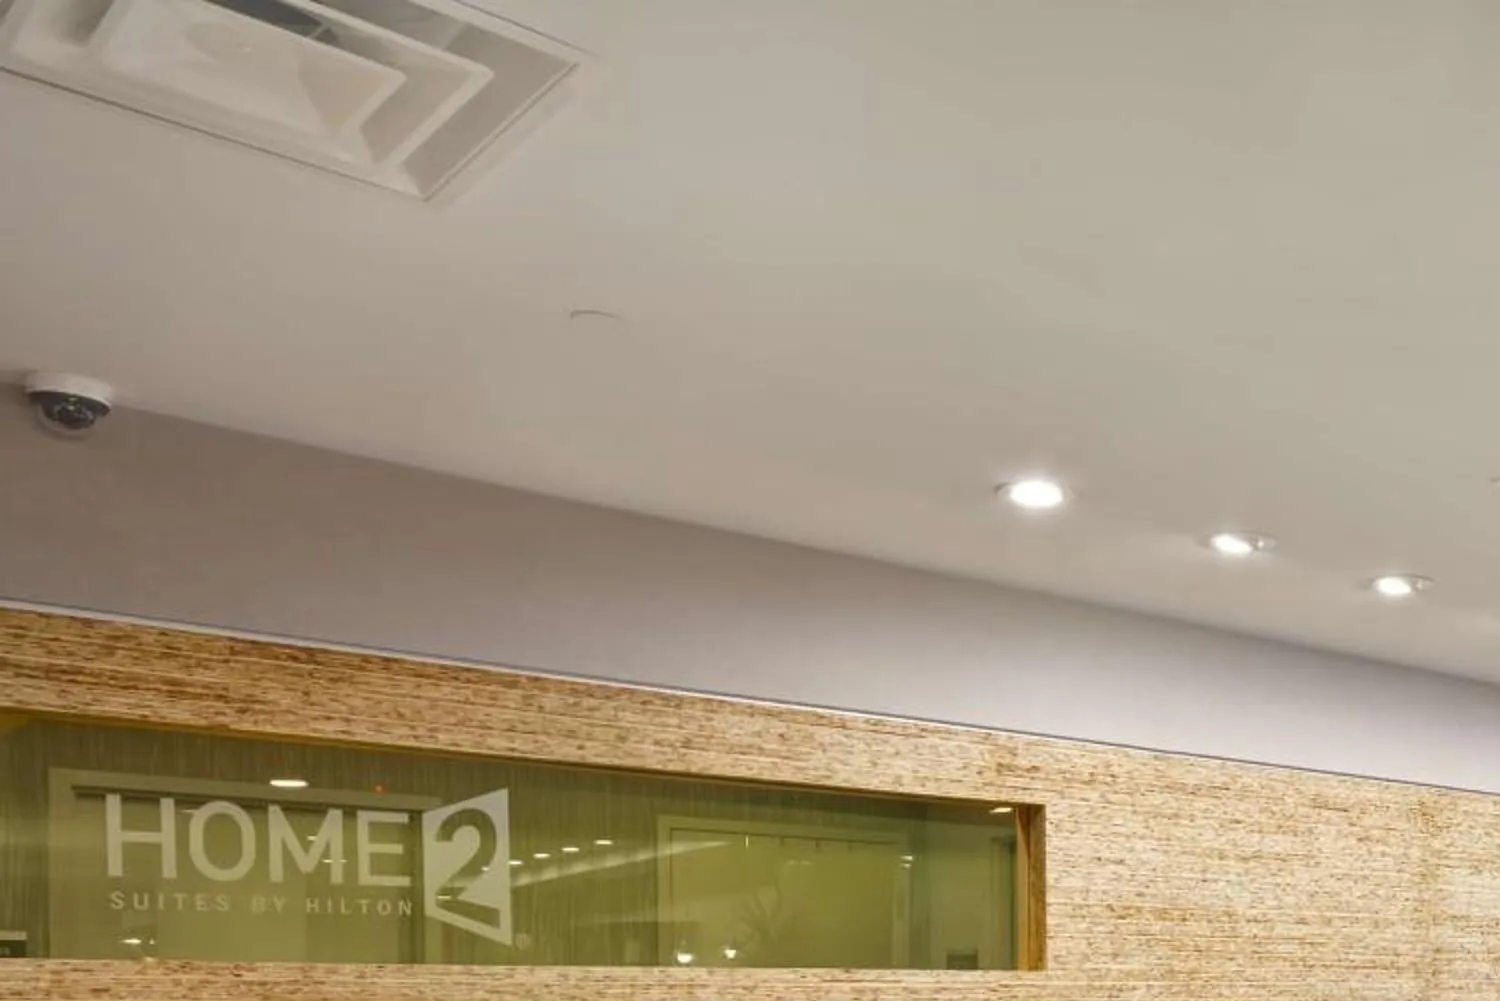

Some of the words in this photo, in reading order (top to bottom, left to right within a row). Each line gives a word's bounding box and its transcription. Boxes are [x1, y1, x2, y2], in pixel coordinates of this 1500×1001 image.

[110, 890, 229, 912] SUITES
[251, 895, 288, 914] BY
[306, 896, 414, 917] HILTON
